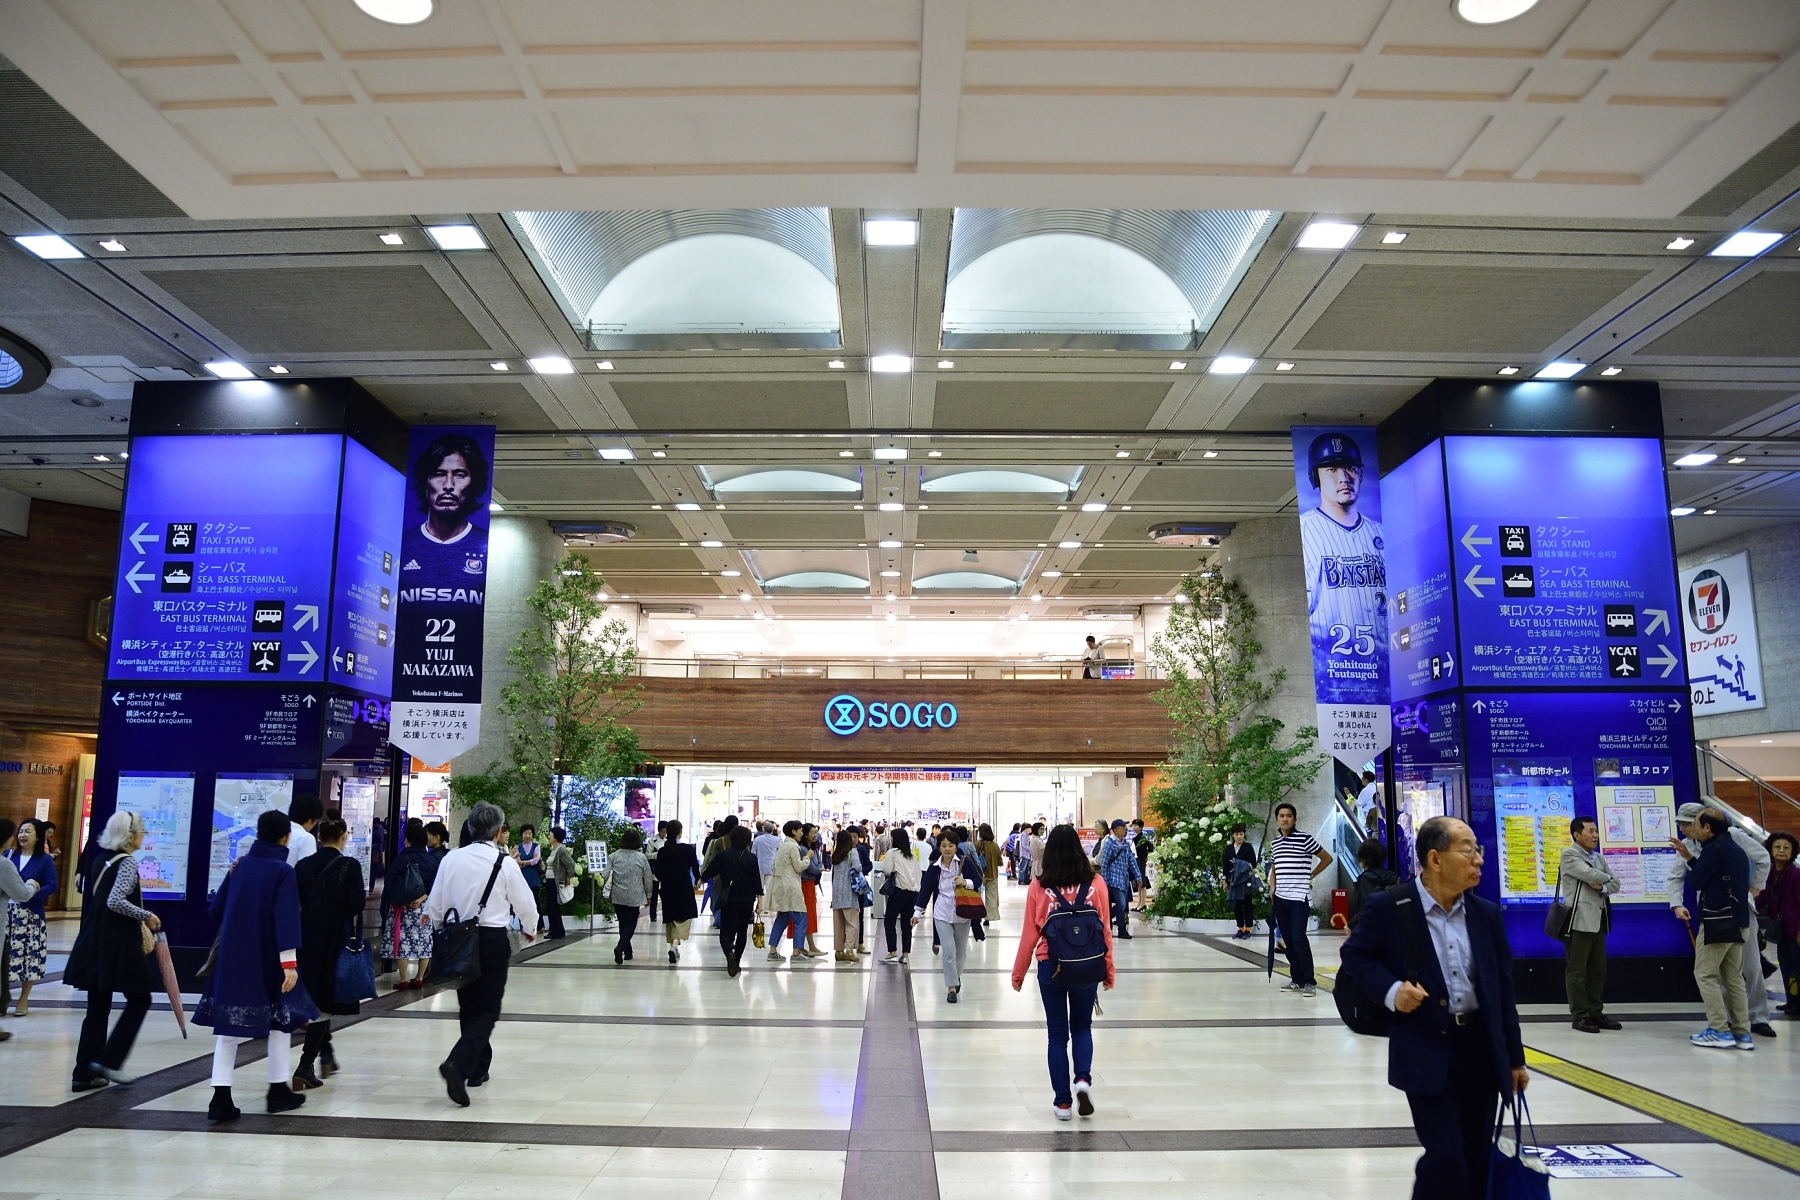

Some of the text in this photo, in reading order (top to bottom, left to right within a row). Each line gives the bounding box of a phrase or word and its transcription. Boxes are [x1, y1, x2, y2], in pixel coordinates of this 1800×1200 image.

[203, 522, 251, 534] タクシー
[1536, 526, 1585, 538] タクシー
[1537, 540, 1591, 548] TAXI STAND
[199, 562, 246, 573] シーバス
[1539, 566, 1588, 578] シーバス
[198, 576, 286, 584] SEA BASS TERMINAL
[1540, 580, 1631, 588] SEA BASS TERMINAL
[400, 588, 483, 605] NISSAN
[153, 601, 247, 612] 東口バスターミナル
[1499, 604, 1598, 616] 東口バスターミナル
[160, 614, 246, 622] EAST BUS TERMINAL
[1510, 619, 1599, 628] EAST BUS TERMINAL
[426, 618, 456, 642] 22
[1330, 624, 1376, 656] 25
[252, 642, 280, 650] YCAT
[1609, 646, 1638, 656] YCAT
[426, 649, 454, 660] YUJI
[402, 664, 474, 676] NAKAZAWA
[1327, 660, 1378, 670] Yoshitomo
[1327, 669, 1378, 680] Tsutsugoh
[128, 692, 182, 700] ポートサイド地区
[1691, 687, 1715, 705] の上
[407, 708, 465, 718] そごう横浜店は
[868, 702, 958, 728] SOGO
[1332, 710, 1377, 718] そごう横浜店は
[402, 720, 468, 729] 横浜F・マリノスを
[403, 731, 464, 740] 応援しています。
[1334, 732, 1376, 740] ベイスターズを
[1600, 734, 1668, 742] 横浜三井ビルディング
[1334, 742, 1380, 750] 応援しています。
[1522, 766, 1570, 776] 新都市ホール
[1622, 766, 1670, 775] 市民フロア
[836, 772, 950, 780] お中元ギフト早期特別ご優待会
